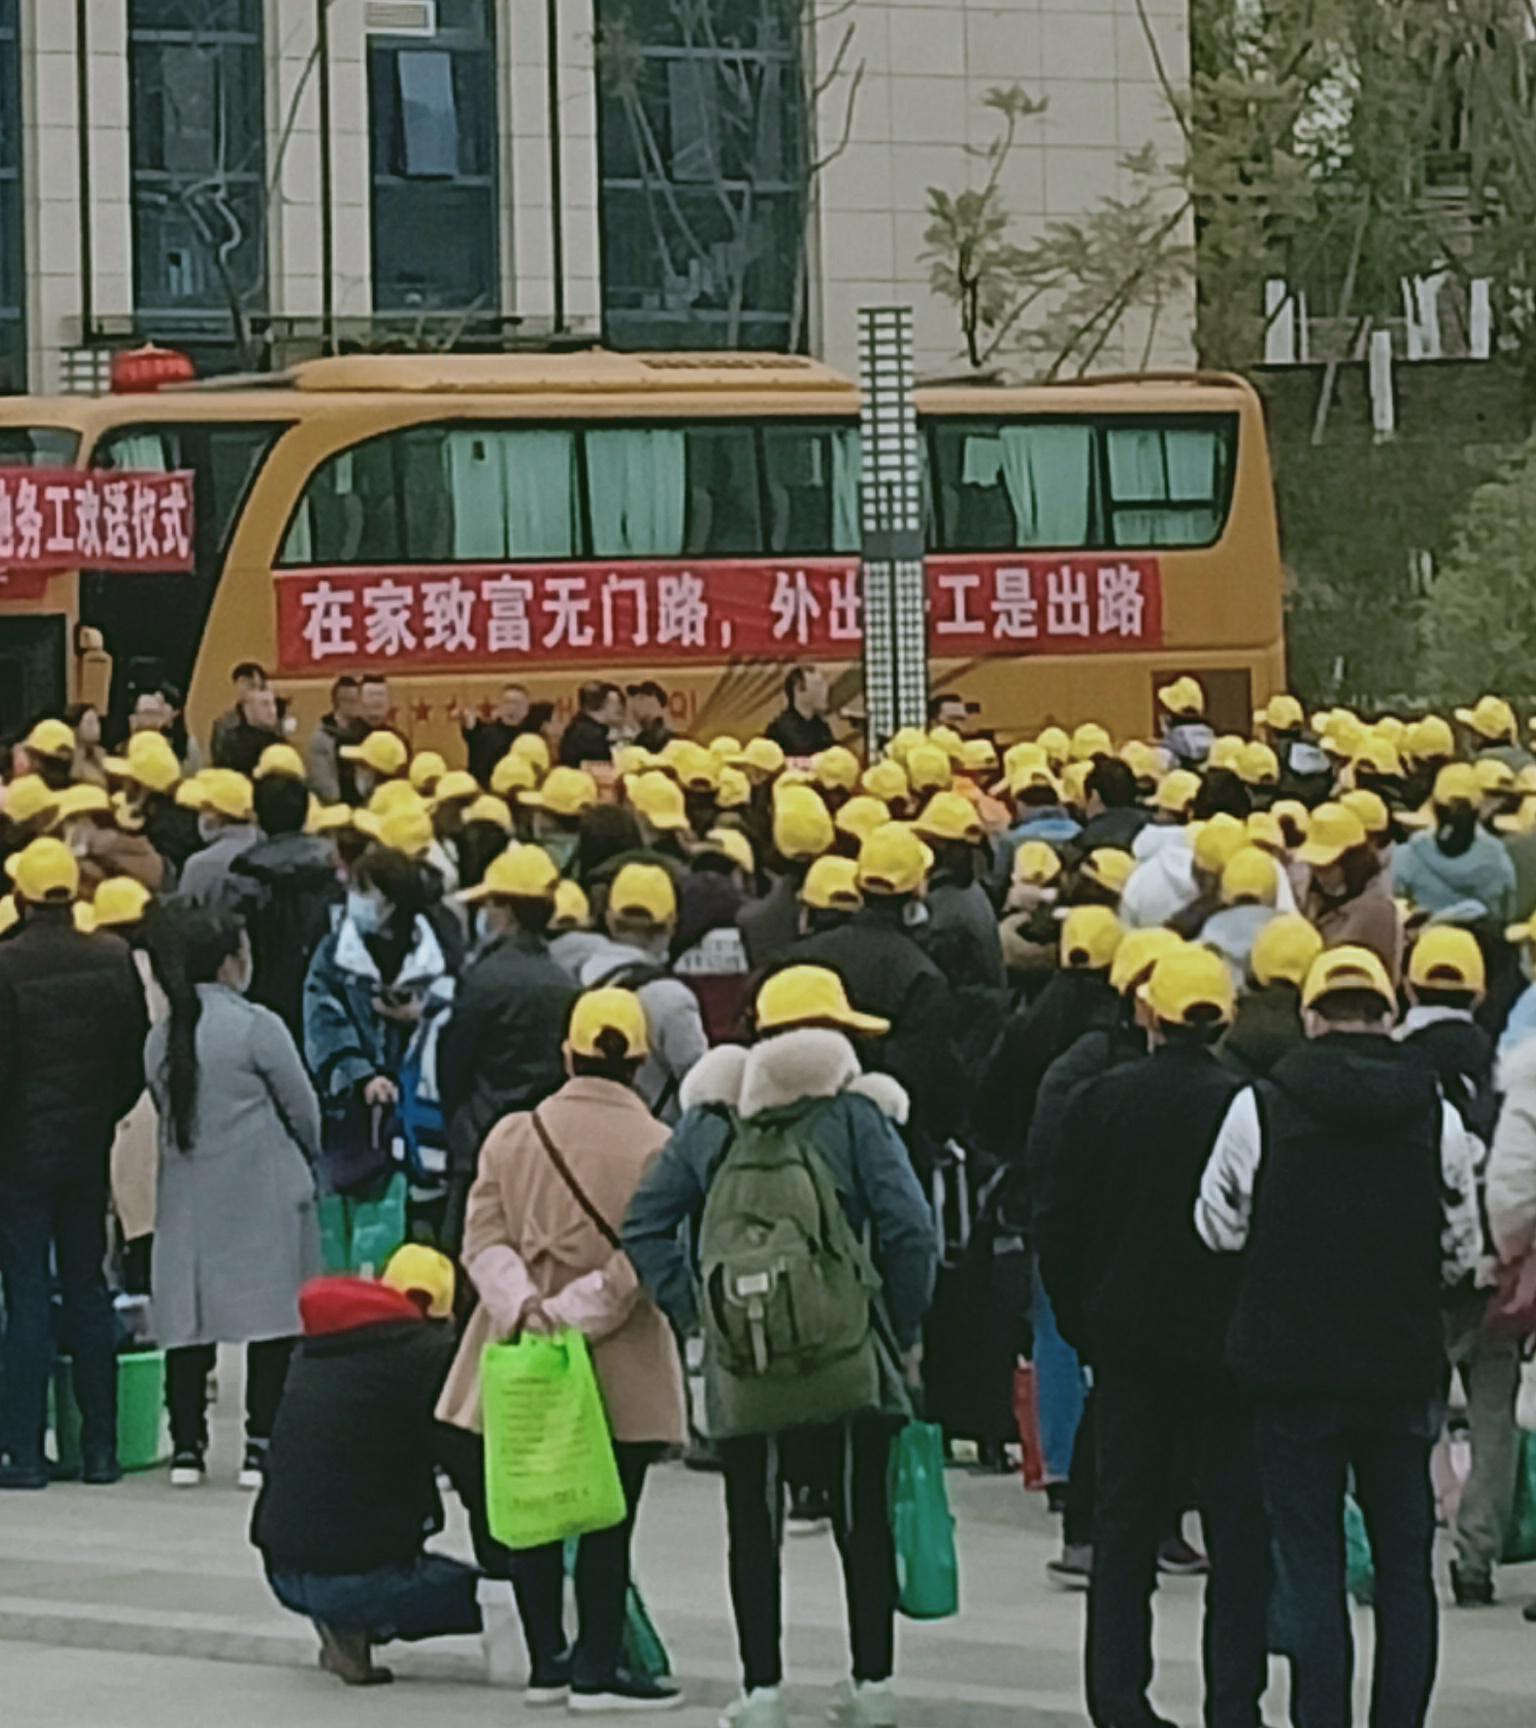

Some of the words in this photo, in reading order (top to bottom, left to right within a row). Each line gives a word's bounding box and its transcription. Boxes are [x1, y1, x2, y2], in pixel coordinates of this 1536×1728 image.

[302, 563, 1144, 659] 在家致富无门路，外出工是出路
